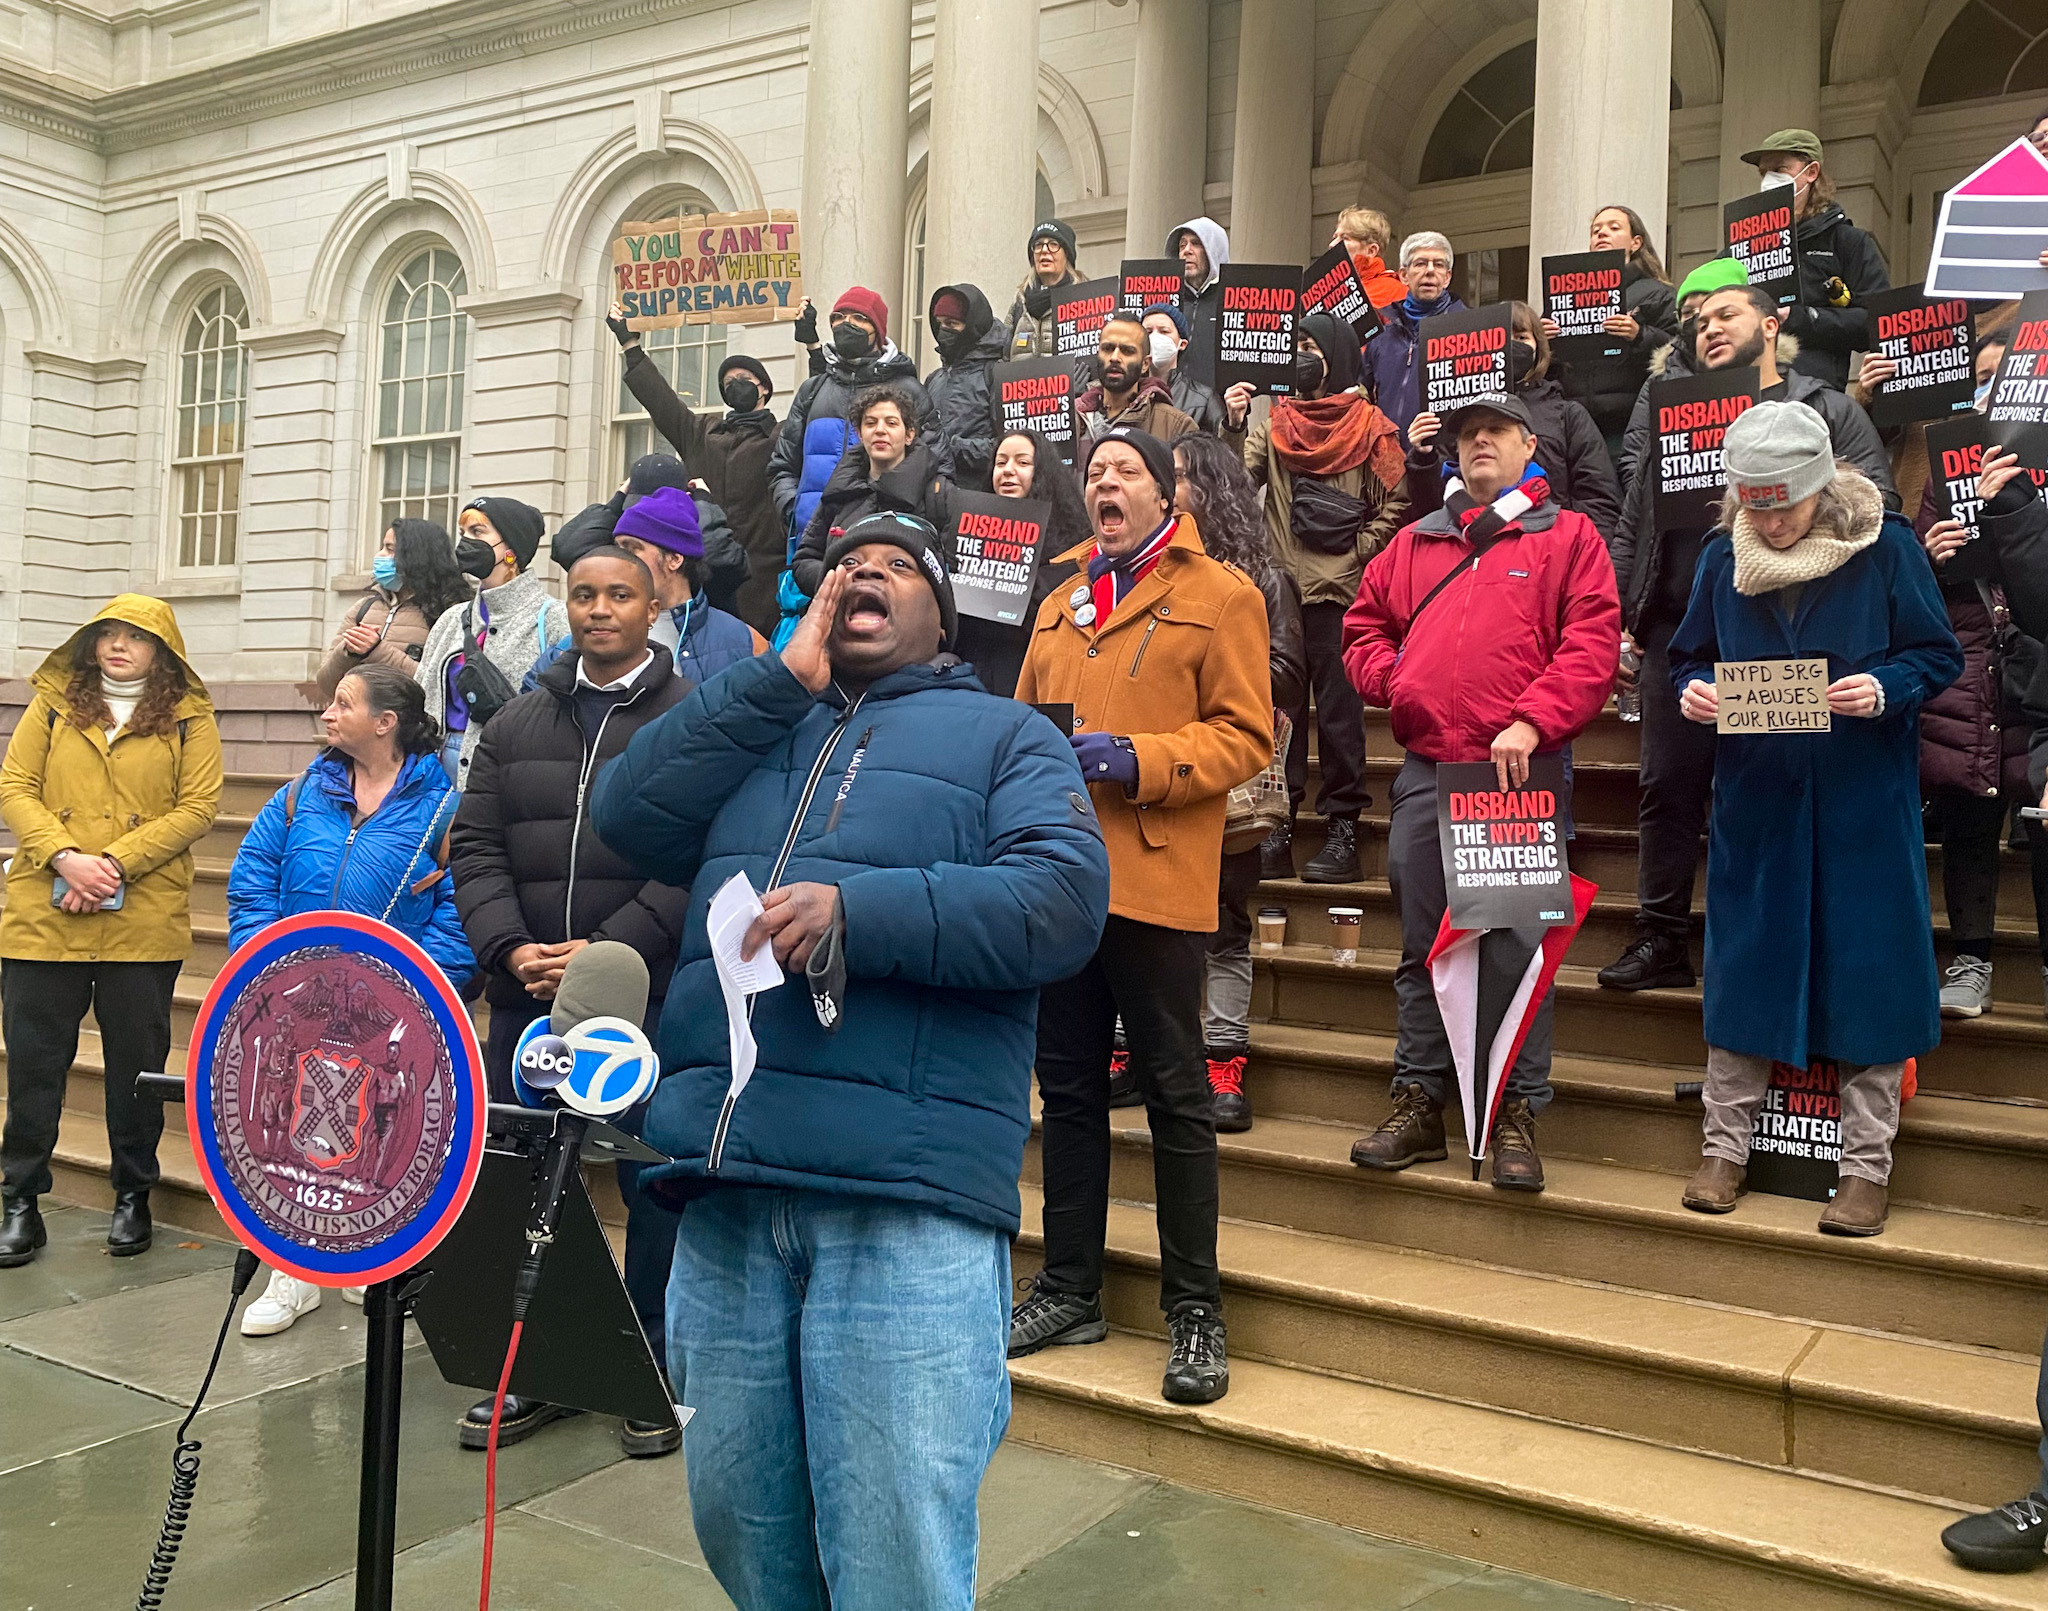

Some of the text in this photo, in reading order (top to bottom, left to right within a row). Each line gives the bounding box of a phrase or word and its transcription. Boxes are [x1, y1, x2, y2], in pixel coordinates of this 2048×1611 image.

[1730, 207, 1790, 242] DISBAND
[624, 224, 794, 262] YOU CAN'T
[1730, 230, 1791, 258] THE NYPD'S
[724, 252, 802, 280] WHITE
[1767, 265, 1794, 280] GROUP
[1124, 276, 1180, 292] DISBAND
[1300, 260, 1352, 312] DISBAND
[1323, 276, 1358, 310] NYPD'S
[1550, 268, 1621, 294] DISBAND
[622, 280, 792, 318] SUPREMACY
[1057, 294, 1115, 322] DISBAND
[1124, 294, 1180, 307] THE NYPD'S
[1224, 286, 1296, 312] DISBAND
[1550, 290, 1621, 310] THE NYPD'S
[1057, 320, 1076, 336] THE
[1222, 312, 1294, 332] THE NYPD'S
[1878, 298, 1968, 340] DISBAND
[1221, 330, 1292, 352] STRATEGIC
[1426, 326, 1506, 361] DISBAND
[1879, 326, 1968, 358] THE NYPD'S
[1221, 350, 1292, 364] RESPONSE GROUP
[1426, 352, 1506, 380] THE NYPD'S
[1892, 346, 1970, 378] TRATEGIC
[2004, 354, 2036, 377] THE
[1002, 374, 1070, 402] DISBAND
[1428, 370, 1506, 400] STRATEGIC
[1882, 373, 1936, 394] RESPONSE
[1002, 395, 1070, 418] THE NYPD'S
[1990, 406, 2043, 422] RESPONSE
[1659, 432, 1690, 455] THE
[1662, 474, 1714, 494] RESPONSE
[1736, 483, 1789, 503] HOPE
[958, 512, 1040, 545] DISBAND
[956, 536, 1035, 564] THE NYPD'S
[995, 581, 1028, 596] GROUP
[1722, 664, 1823, 682] NYPD SRG
[1746, 688, 1818, 704] ABUSES
[1728, 710, 1829, 728] OUR RIGHTS
[834, 748, 866, 802] NAUTICA
[1450, 790, 1556, 822] DISBAND
[1450, 821, 1556, 846] THE NYPD'S
[1454, 844, 1558, 871] STRATEGIC
[1457, 870, 1562, 888] RESPONSE GROUP
[520, 1046, 573, 1074] abc
[296, 1184, 344, 1212] 1625
